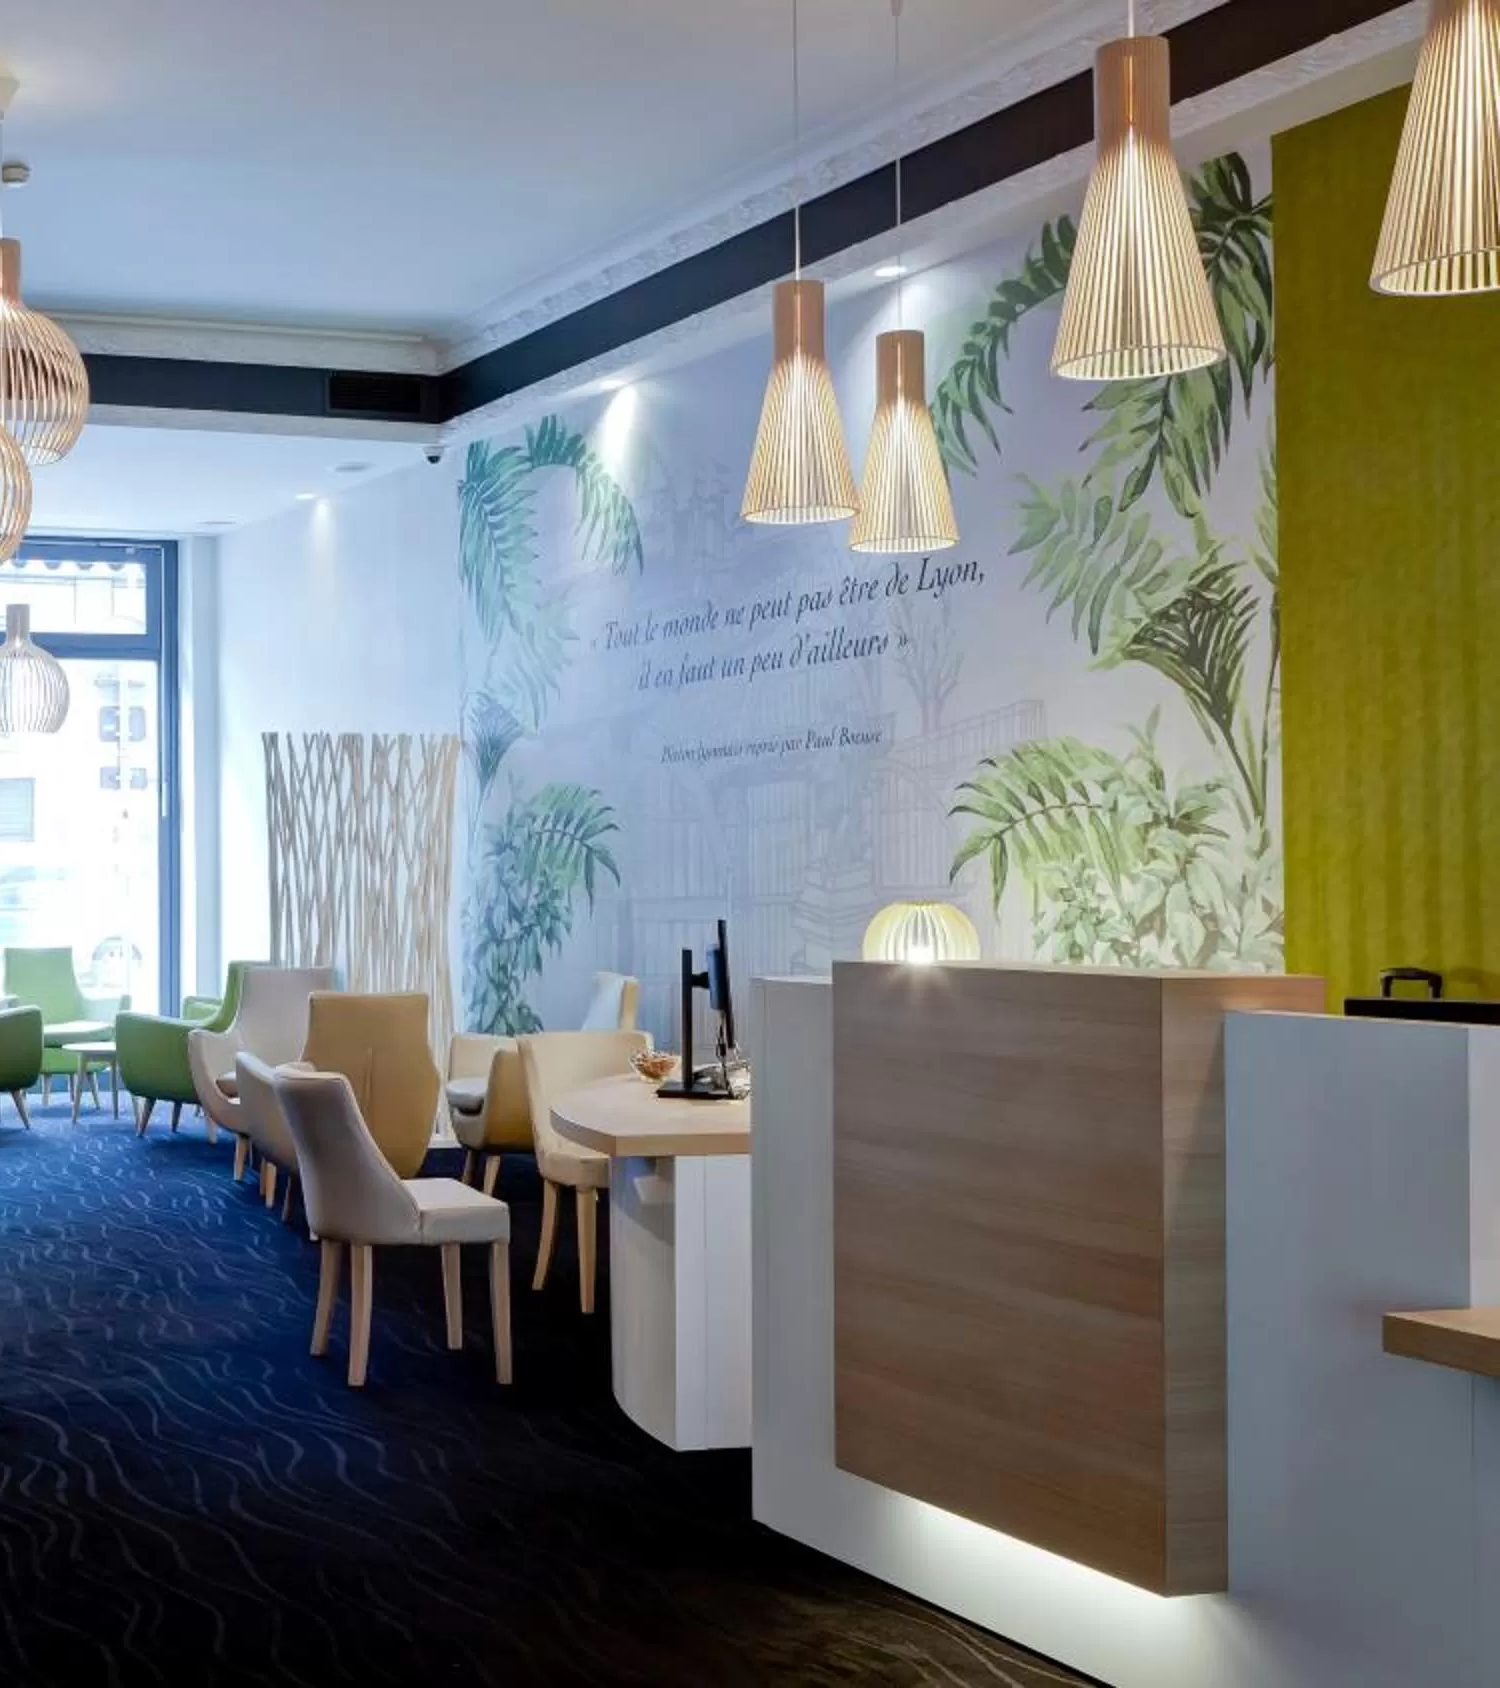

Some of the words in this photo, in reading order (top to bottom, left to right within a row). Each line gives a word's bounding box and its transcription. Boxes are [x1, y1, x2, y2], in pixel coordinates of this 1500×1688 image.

[603, 618, 639, 649] Tout
[644, 610, 660, 642] le
[663, 600, 719, 640] monde
[724, 607, 745, 625] ne
[748, 591, 792, 631] peut
[795, 587, 833, 624] pas
[839, 575, 879, 606] être
[885, 561, 909, 598] de
[916, 555, 985, 599] Lyon,
[637, 659, 650, 690] il
[654, 668, 674, 688] en
[677, 651, 716, 690] faut
[720, 655, 745, 679] un
[747, 651, 783, 682] peu
[805, 725, 837, 749] Paul
